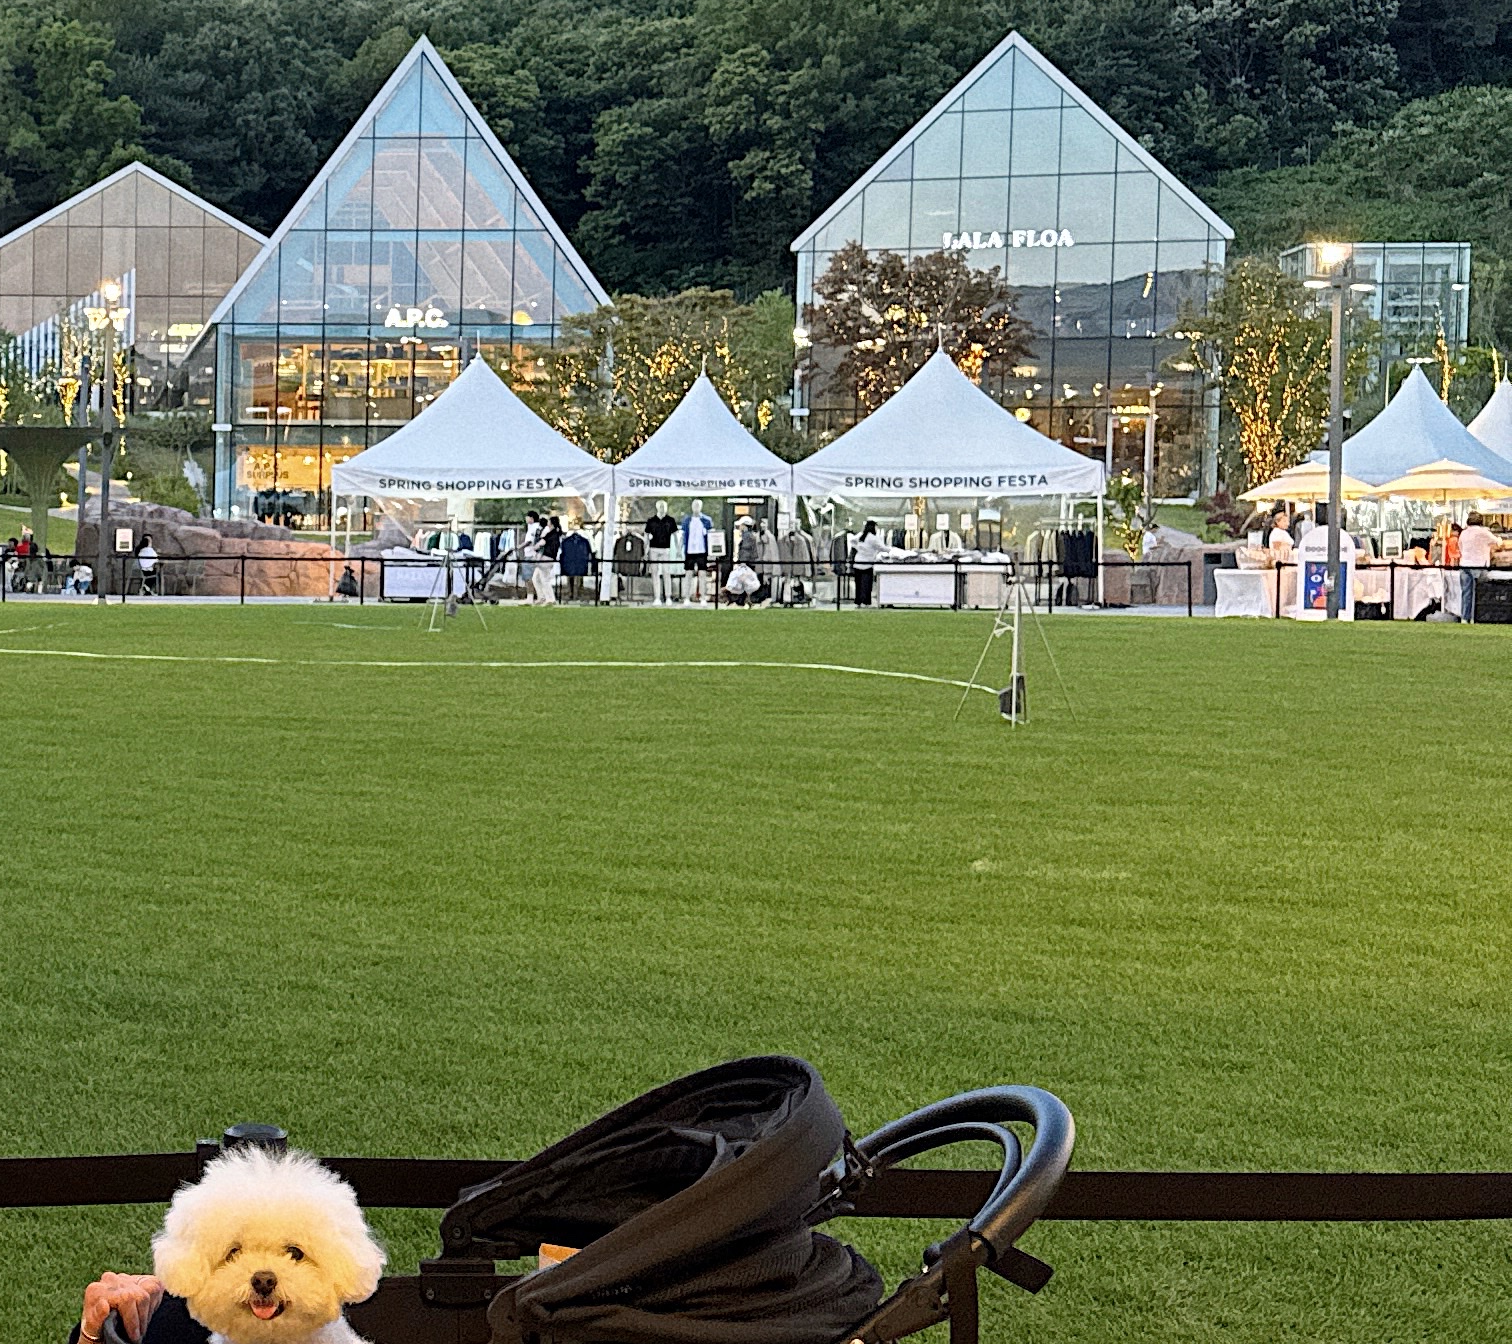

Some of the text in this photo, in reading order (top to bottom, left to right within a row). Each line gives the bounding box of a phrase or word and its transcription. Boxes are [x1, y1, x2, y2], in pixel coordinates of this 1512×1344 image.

[942, 228, 1075, 250] LALA FLOA
[384, 308, 449, 328] A.P.C.
[378, 477, 565, 492] SPRING SHOPPING FESTA
[628, 478, 672, 488] SPRING
[739, 478, 778, 488] FESTA
[844, 474, 1049, 489] SPRING SHOPPING FESTA
